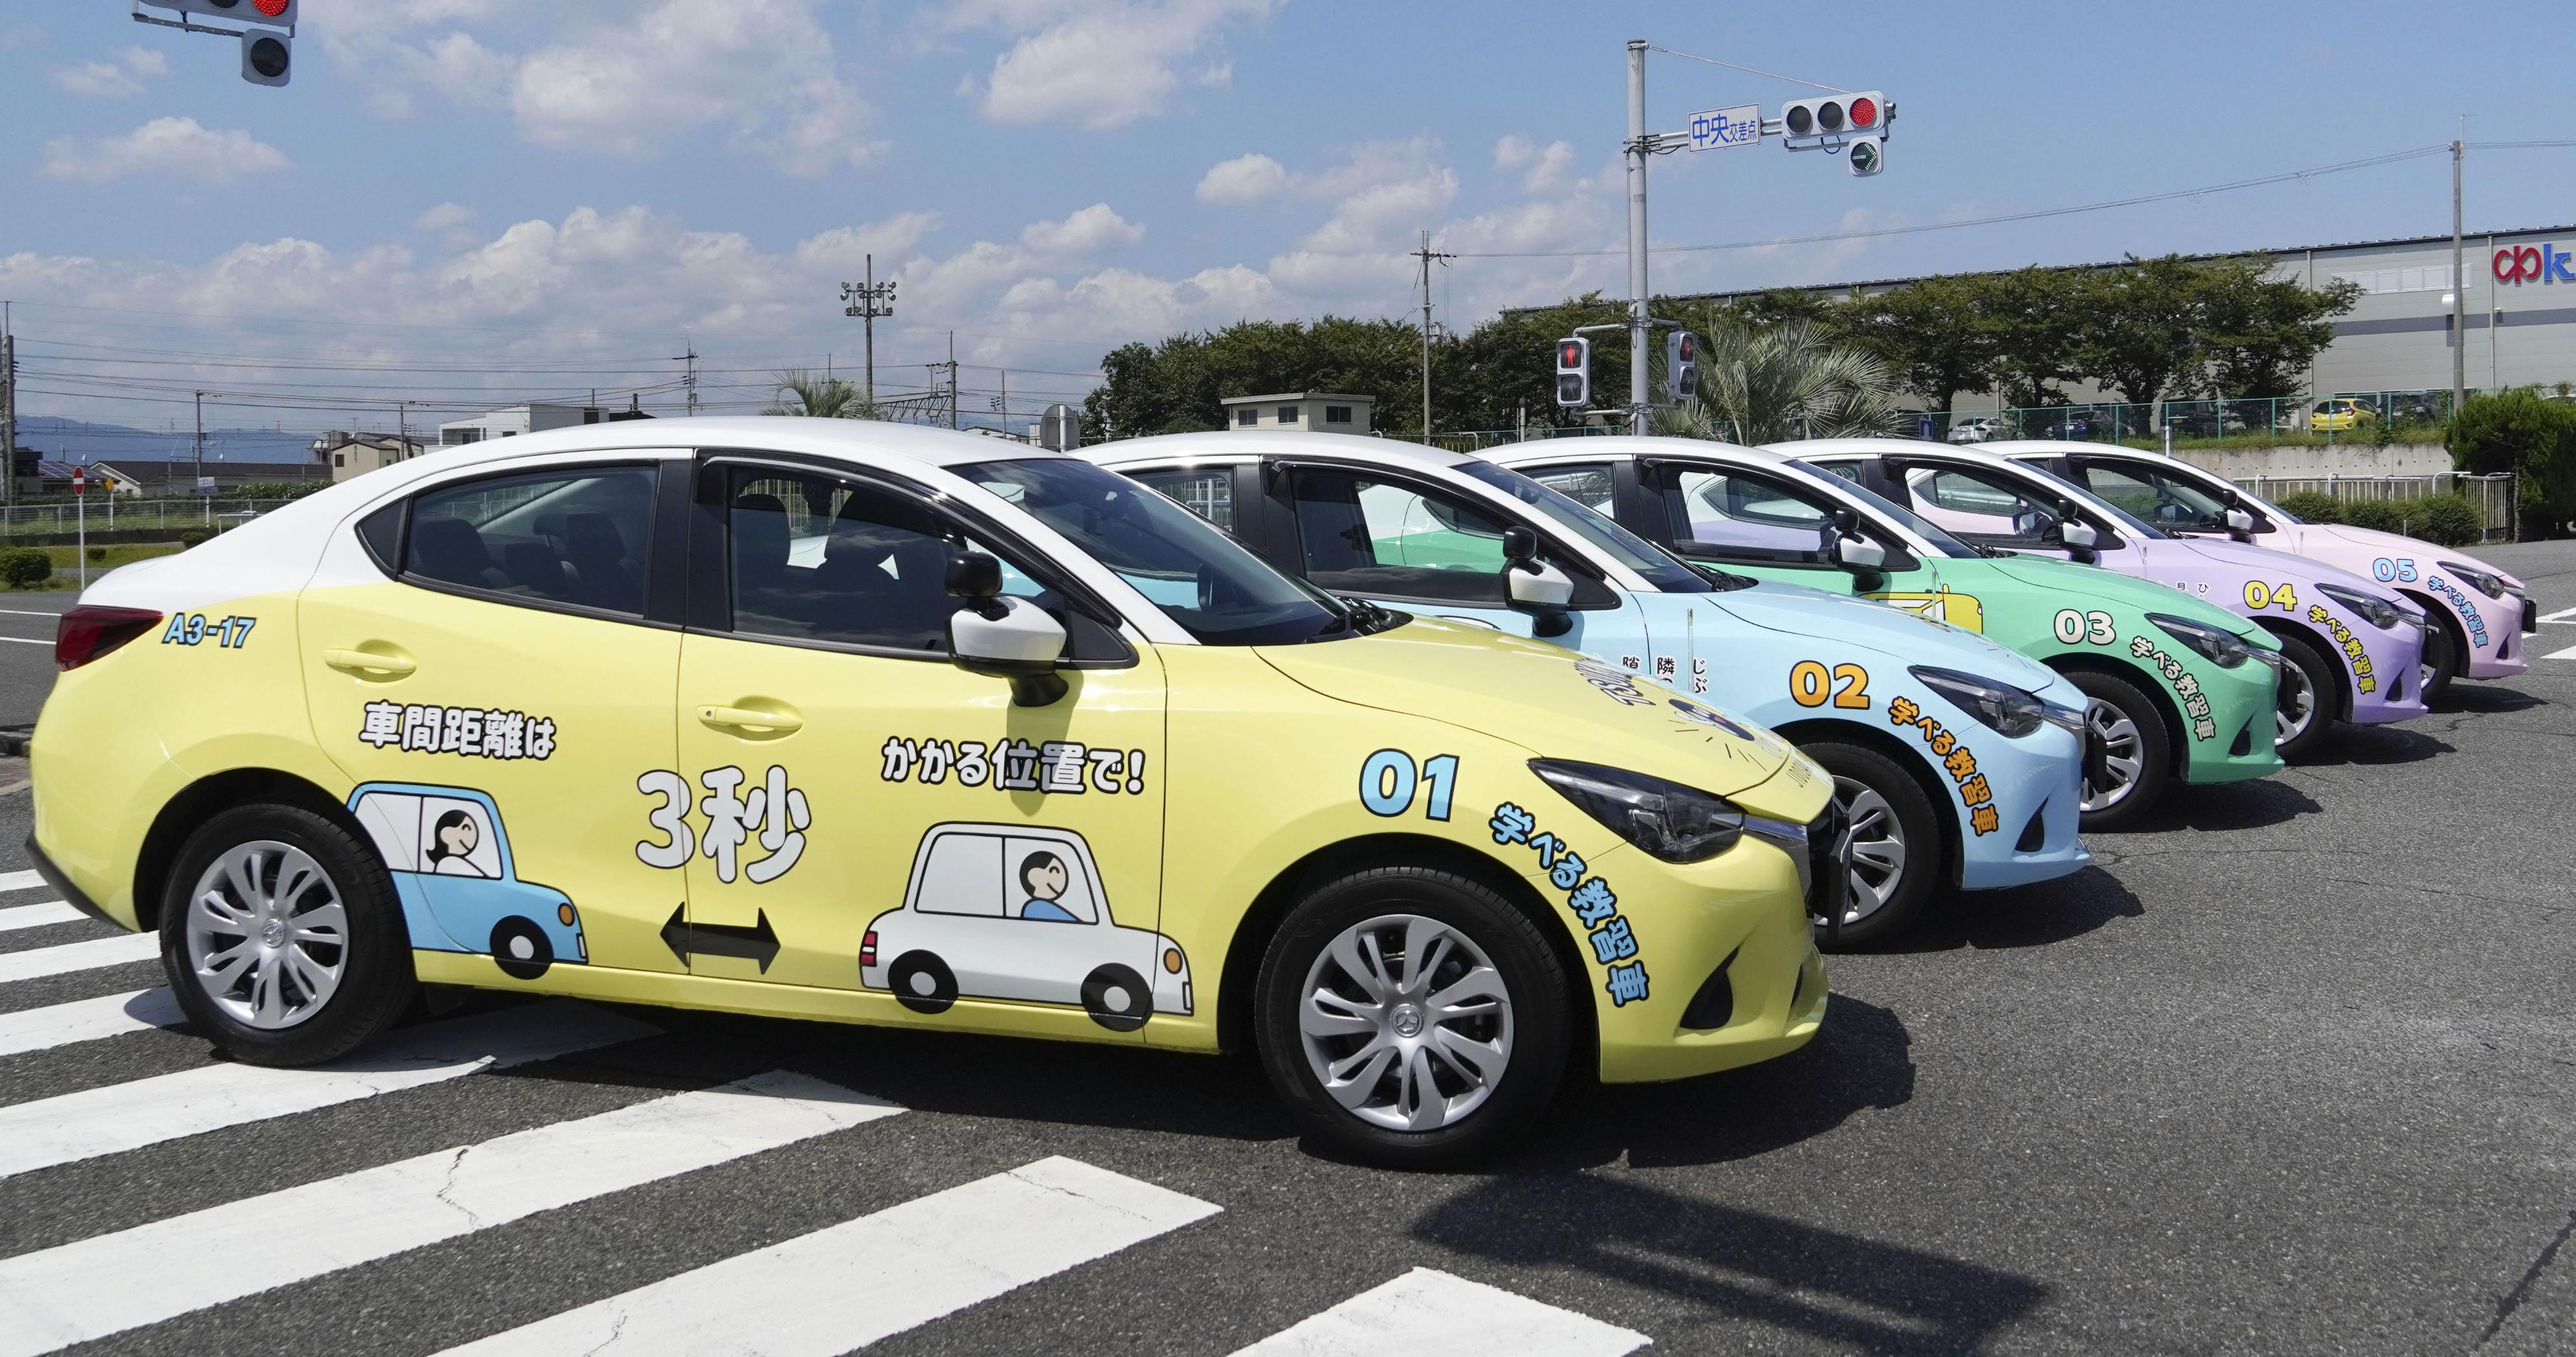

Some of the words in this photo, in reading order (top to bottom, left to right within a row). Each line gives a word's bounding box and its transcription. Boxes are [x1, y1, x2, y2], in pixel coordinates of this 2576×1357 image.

[1692, 113, 1757, 147] 中央交差点
[2243, 580, 2297, 612] 04
[2372, 558, 2418, 582] 05
[162, 612, 258, 649] A3-17
[2053, 609, 2116, 645] 03
[2427, 575, 2488, 648] 学べる教習車
[2307, 604, 2375, 694] 学べる教習車
[1789, 660, 1870, 709] 02
[2130, 635, 2215, 741] 学べる教習車
[359, 699, 556, 760] 車間距離は
[881, 736, 1145, 795] かかる位置で!
[1359, 748, 1460, 822] 01
[1887, 696, 1999, 837] 学べる教習車
[636, 765, 811, 884] 3秒
[1489, 801, 1650, 1008] 学べる教習車
